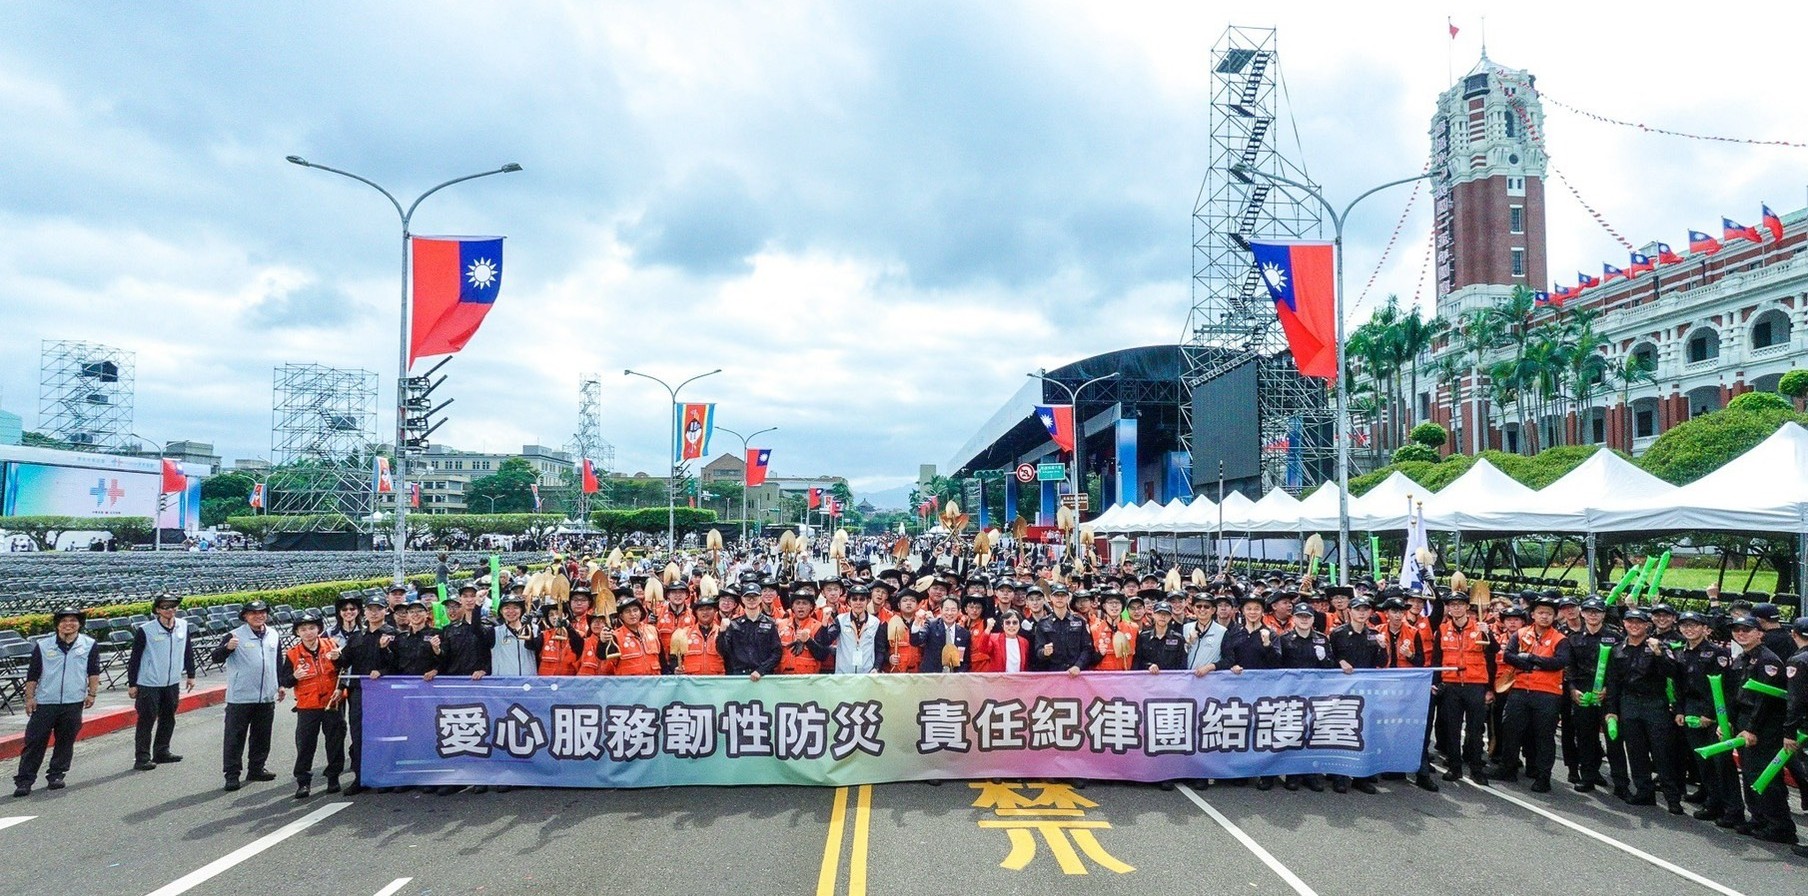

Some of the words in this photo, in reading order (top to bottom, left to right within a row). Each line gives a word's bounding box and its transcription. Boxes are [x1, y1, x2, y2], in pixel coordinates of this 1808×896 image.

[438, 703, 883, 759] 愛心服務韌性防災
[919, 699, 1362, 755] 責任紀律團結護臺
[967, 781, 1137, 875] 禁
